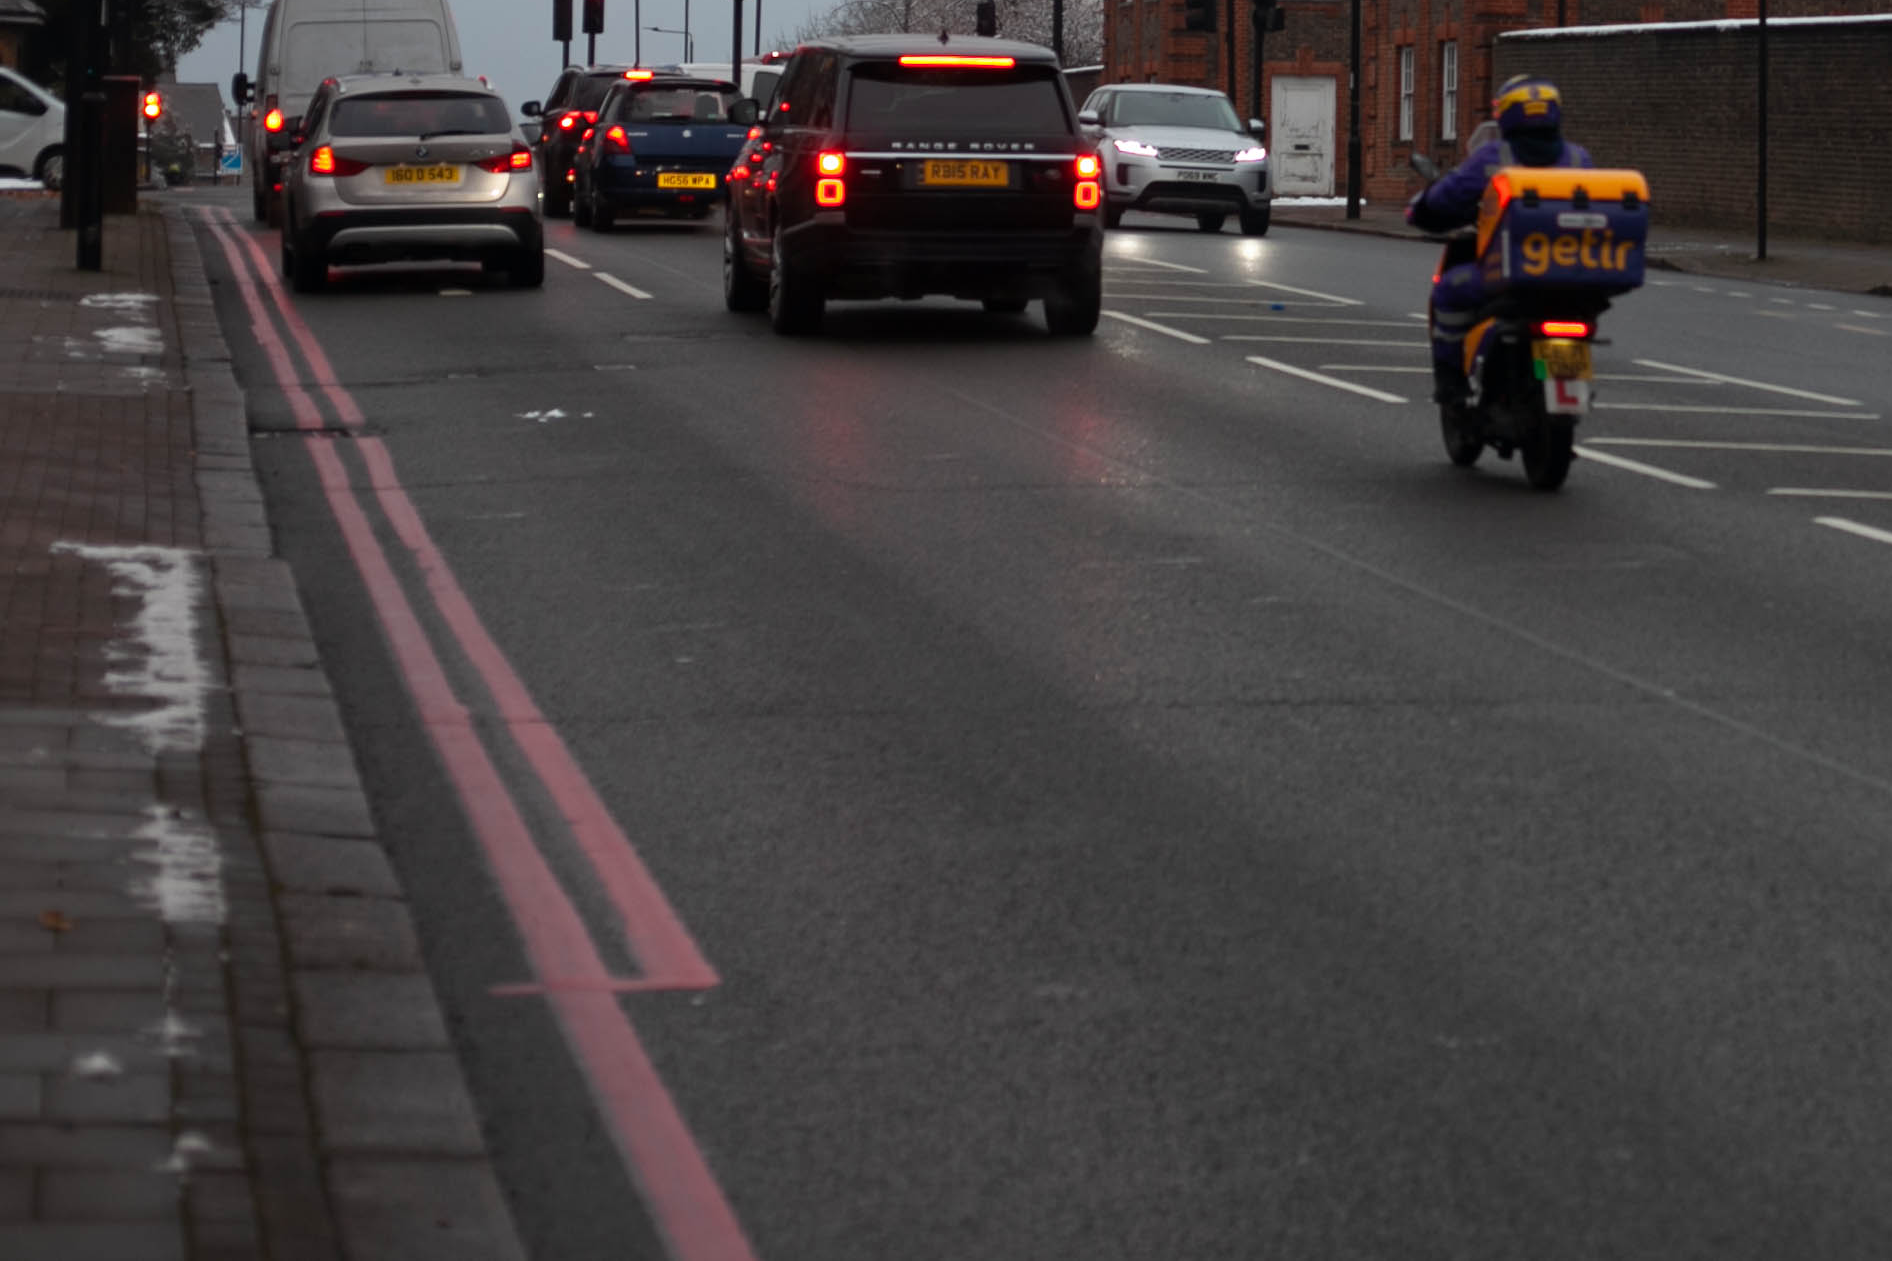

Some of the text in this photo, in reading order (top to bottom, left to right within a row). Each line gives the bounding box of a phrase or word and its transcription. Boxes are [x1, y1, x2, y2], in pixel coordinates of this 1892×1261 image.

[891, 142, 1035, 150] RANGE ROVER
[970, 164, 1001, 180] RAY
[1521, 227, 1637, 276] getir
[1555, 377, 1579, 405] L
